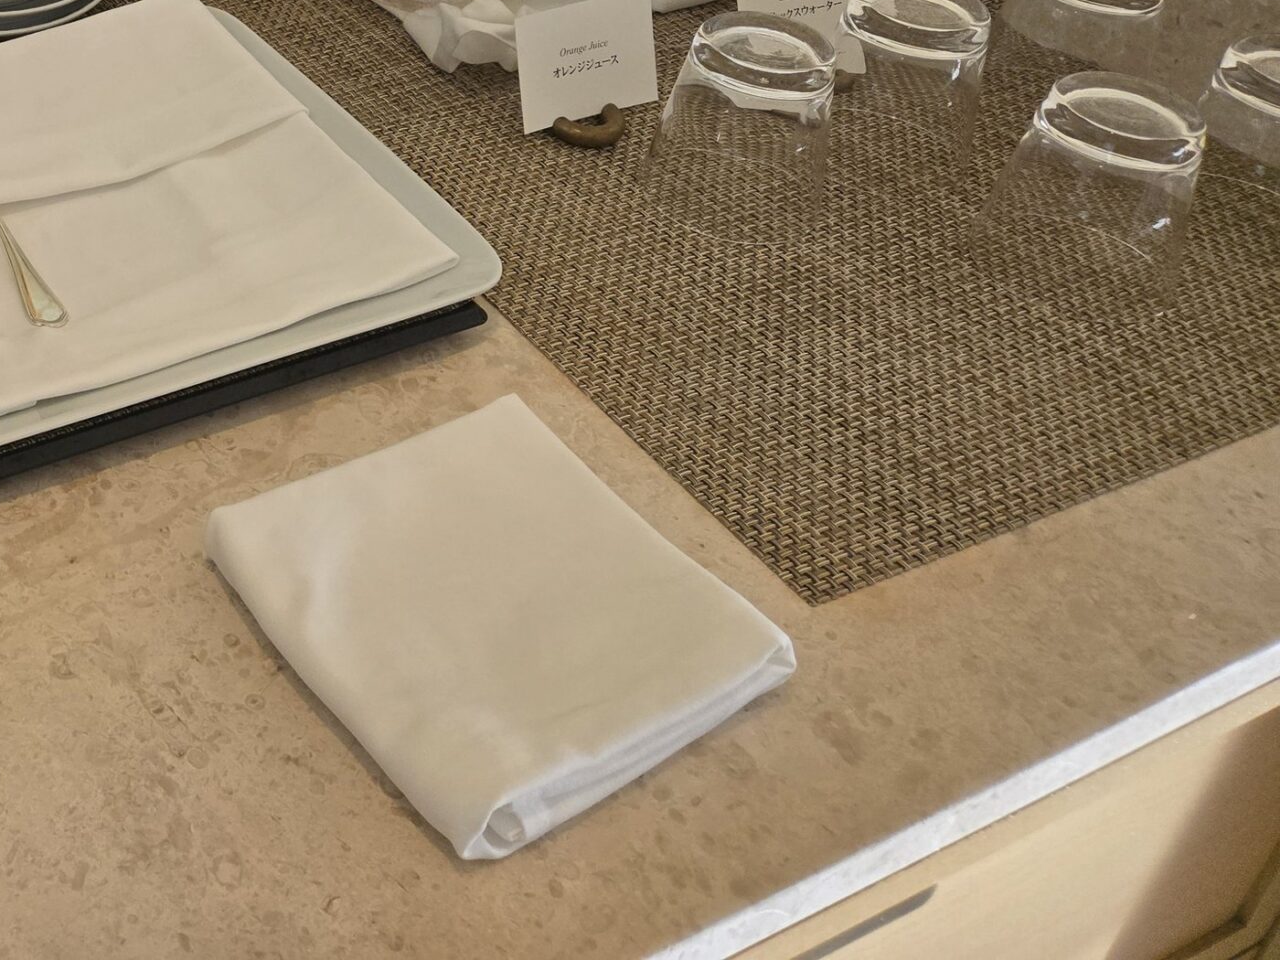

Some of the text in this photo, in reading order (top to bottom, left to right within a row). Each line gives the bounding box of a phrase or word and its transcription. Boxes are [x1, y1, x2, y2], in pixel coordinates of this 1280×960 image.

[559, 40, 609, 58] Orange Juice
[552, 54, 619, 79] オレンジジュース
